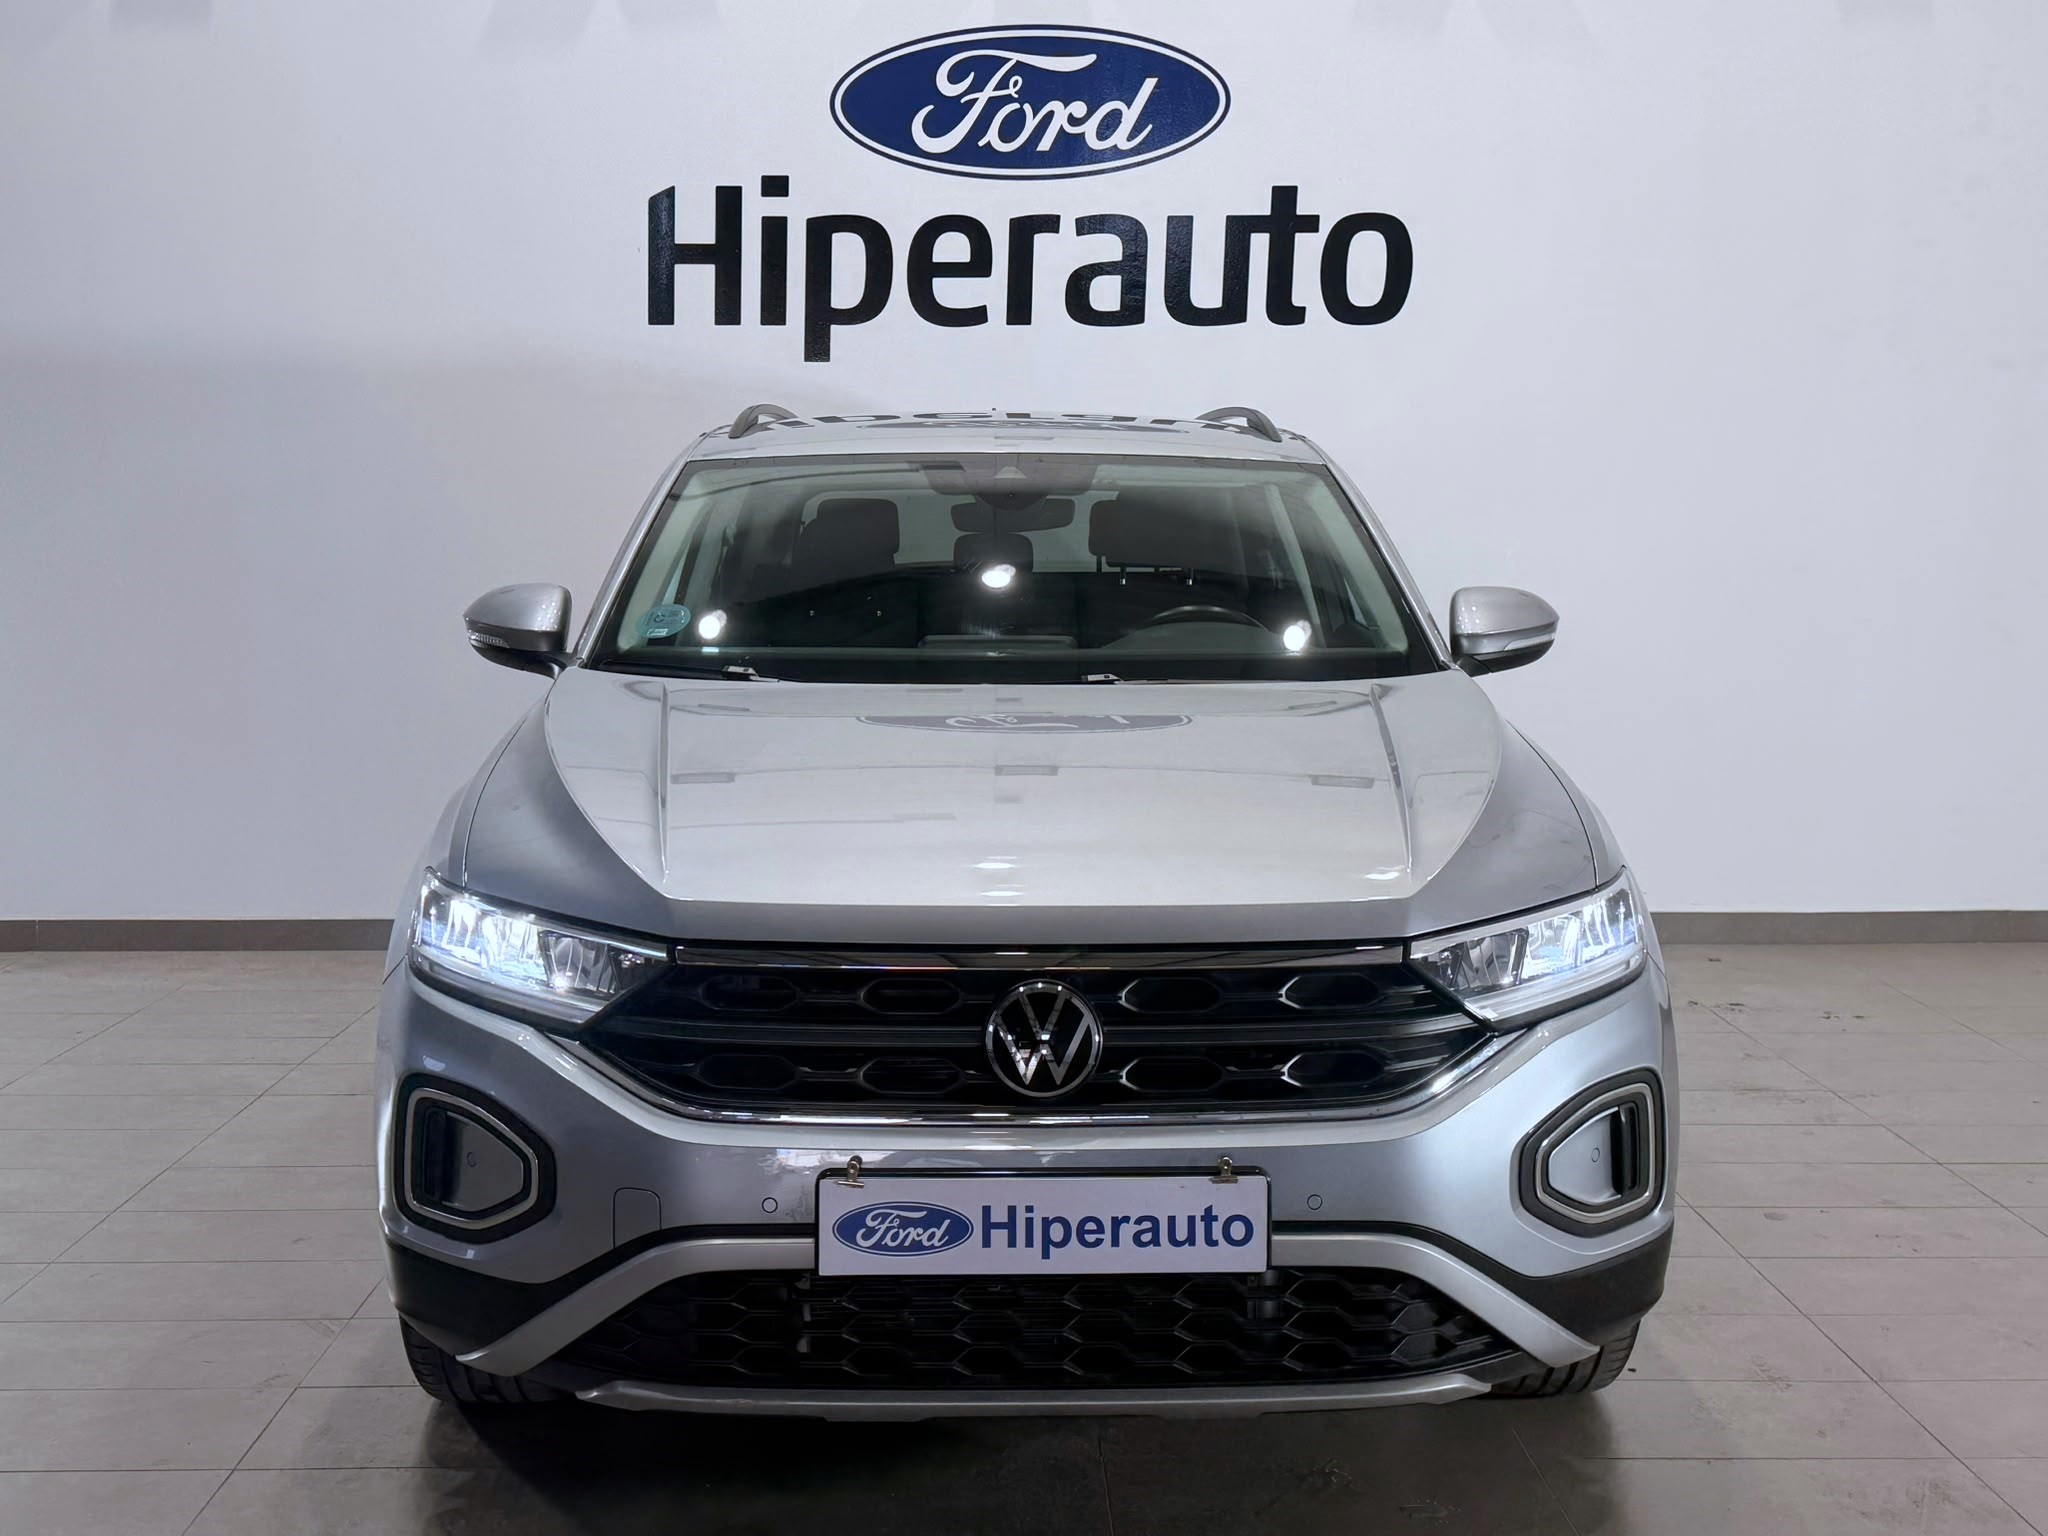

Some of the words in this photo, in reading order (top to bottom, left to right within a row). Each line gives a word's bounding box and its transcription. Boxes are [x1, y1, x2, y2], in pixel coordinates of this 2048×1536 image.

[911, 49, 1158, 153] Ford
[648, 175, 1414, 363] Hiperauto
[855, 1208, 951, 1248] Ford
[981, 1204, 1255, 1260] Hiperauto
